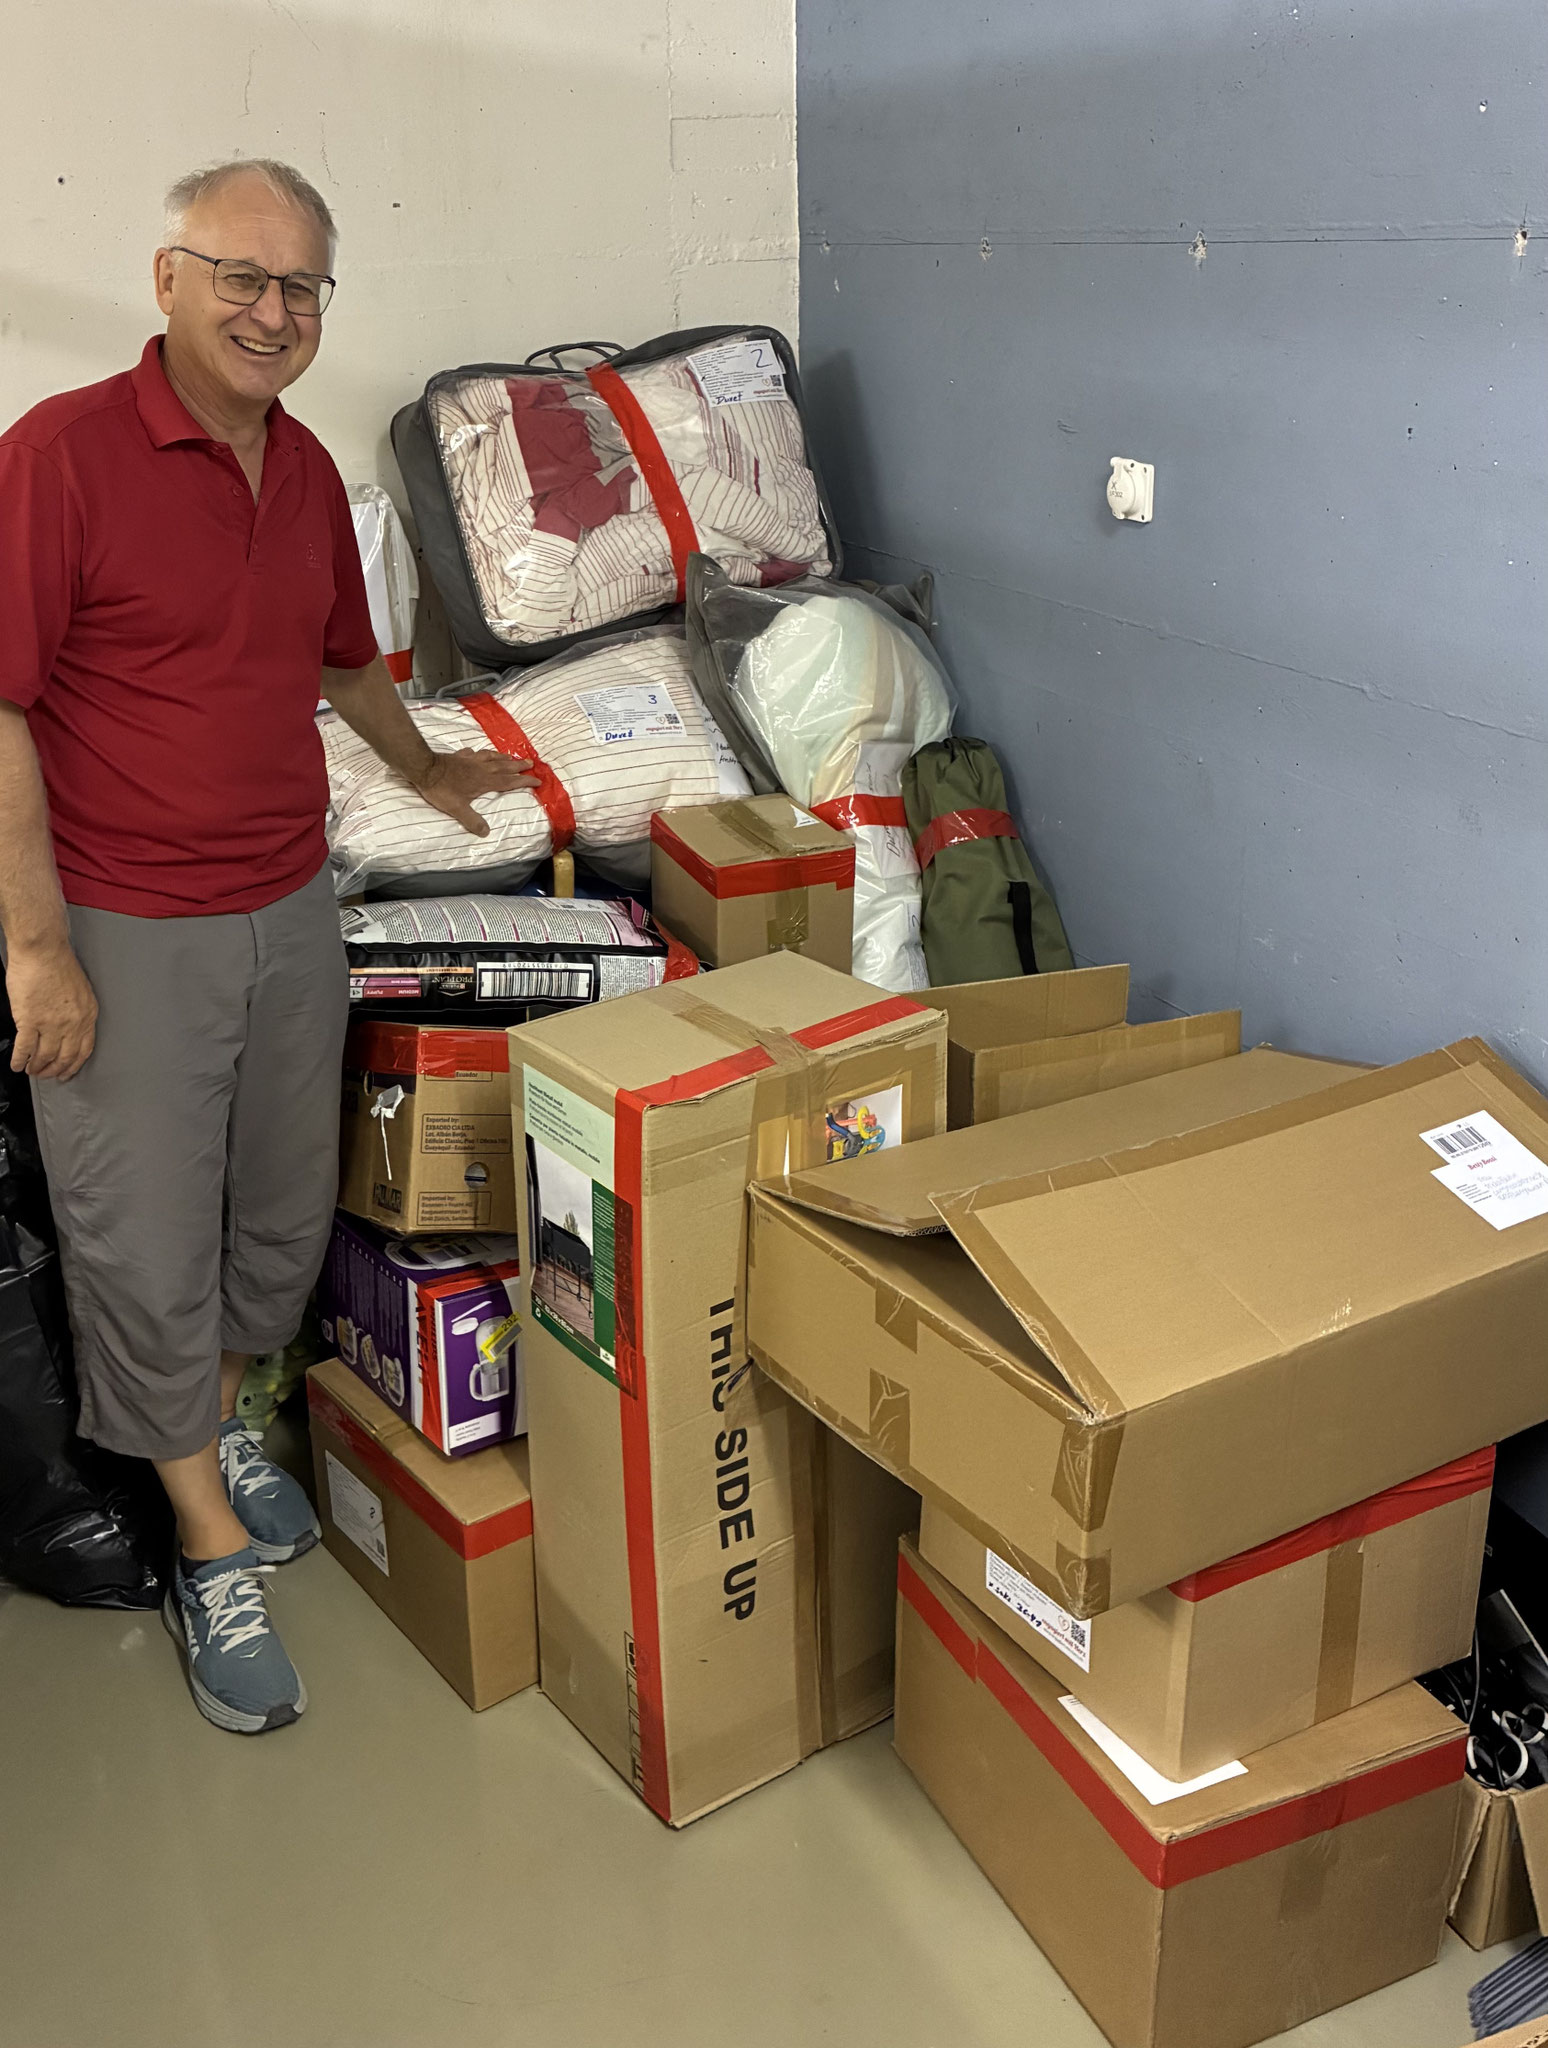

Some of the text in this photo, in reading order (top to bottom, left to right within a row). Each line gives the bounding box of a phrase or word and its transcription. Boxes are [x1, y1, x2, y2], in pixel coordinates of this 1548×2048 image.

[750, 348, 773, 368] 2
[648, 694, 658, 705] 3
[426, 1116, 450, 1124] Exported
[501, 1314, 519, 1331] 292
[715, 1428, 755, 1550] SIDE
[724, 1558, 758, 1621] UP
